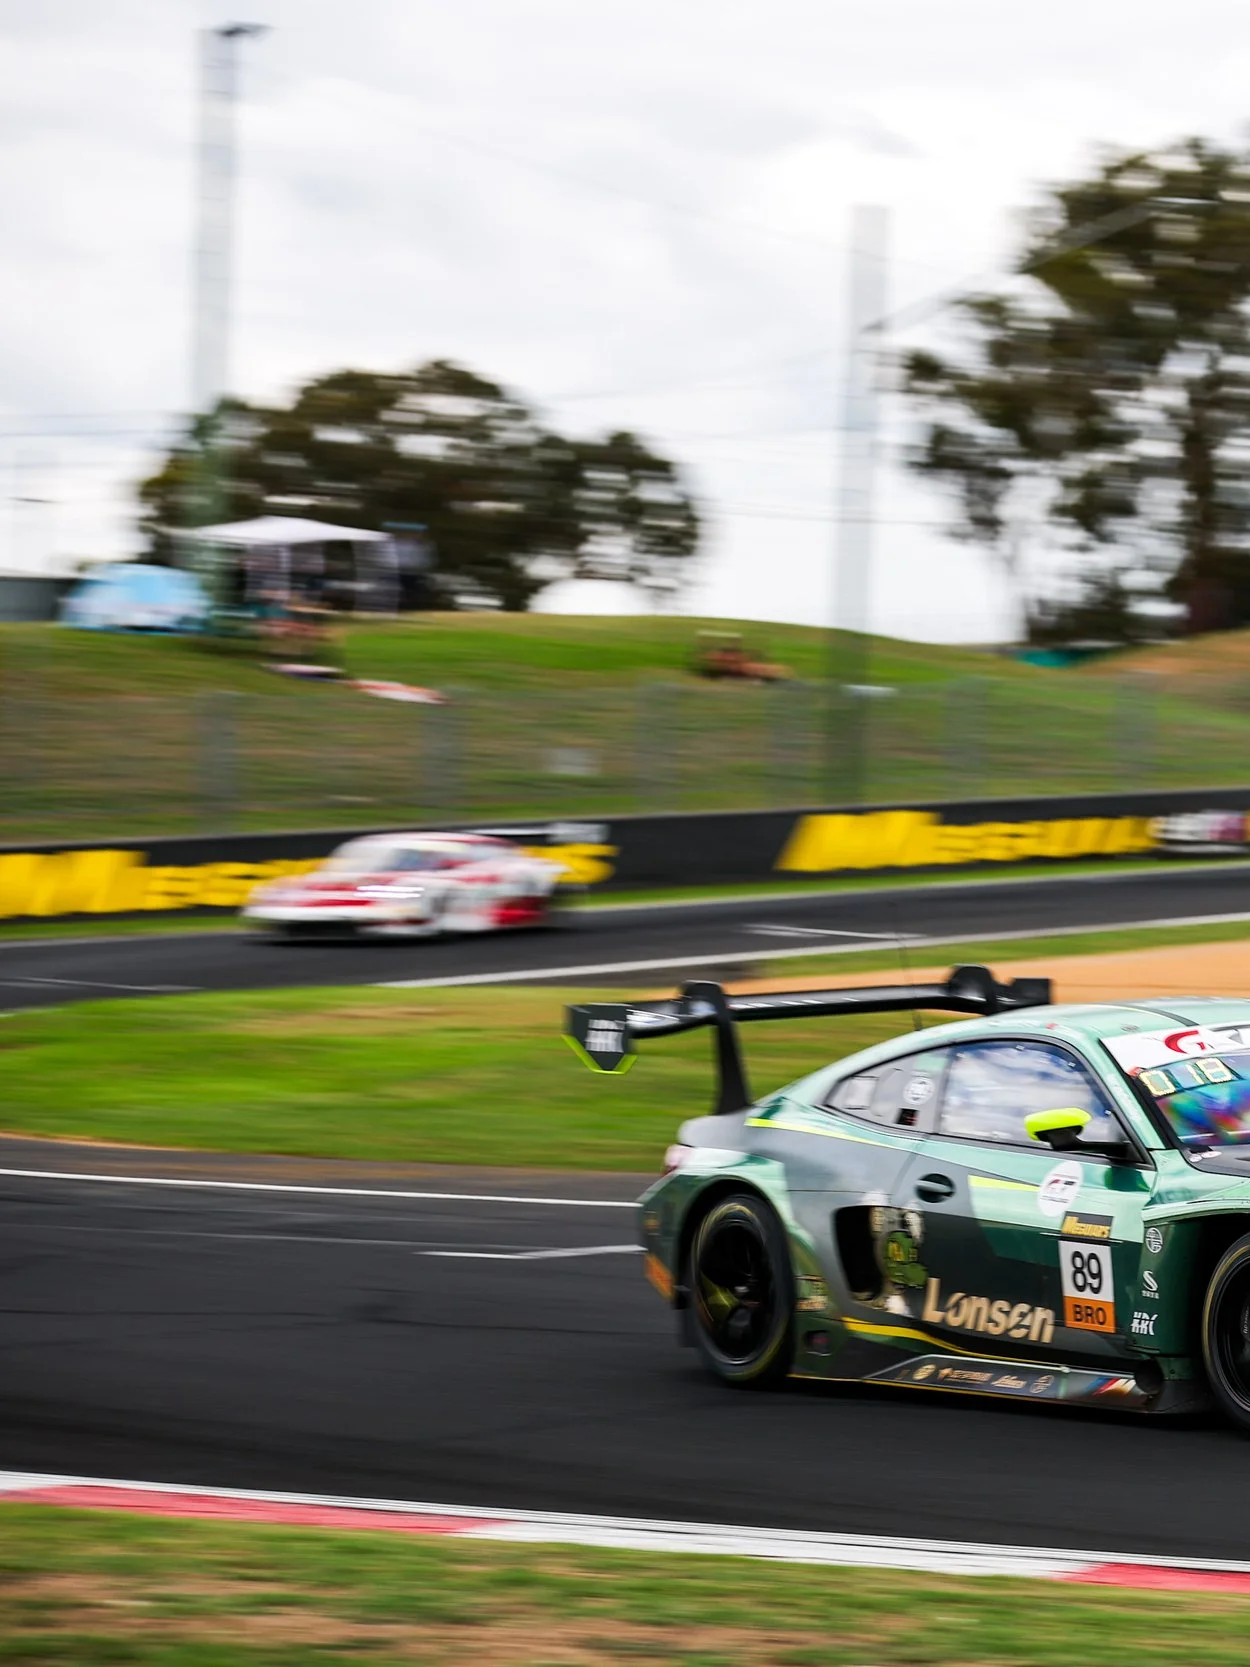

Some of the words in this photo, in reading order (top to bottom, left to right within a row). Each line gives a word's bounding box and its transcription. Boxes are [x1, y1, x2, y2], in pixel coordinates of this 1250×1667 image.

[1071, 1250, 1103, 1295] 89
[922, 1277, 1055, 1344] Lonsen
[1073, 1303, 1107, 1326] BRO
